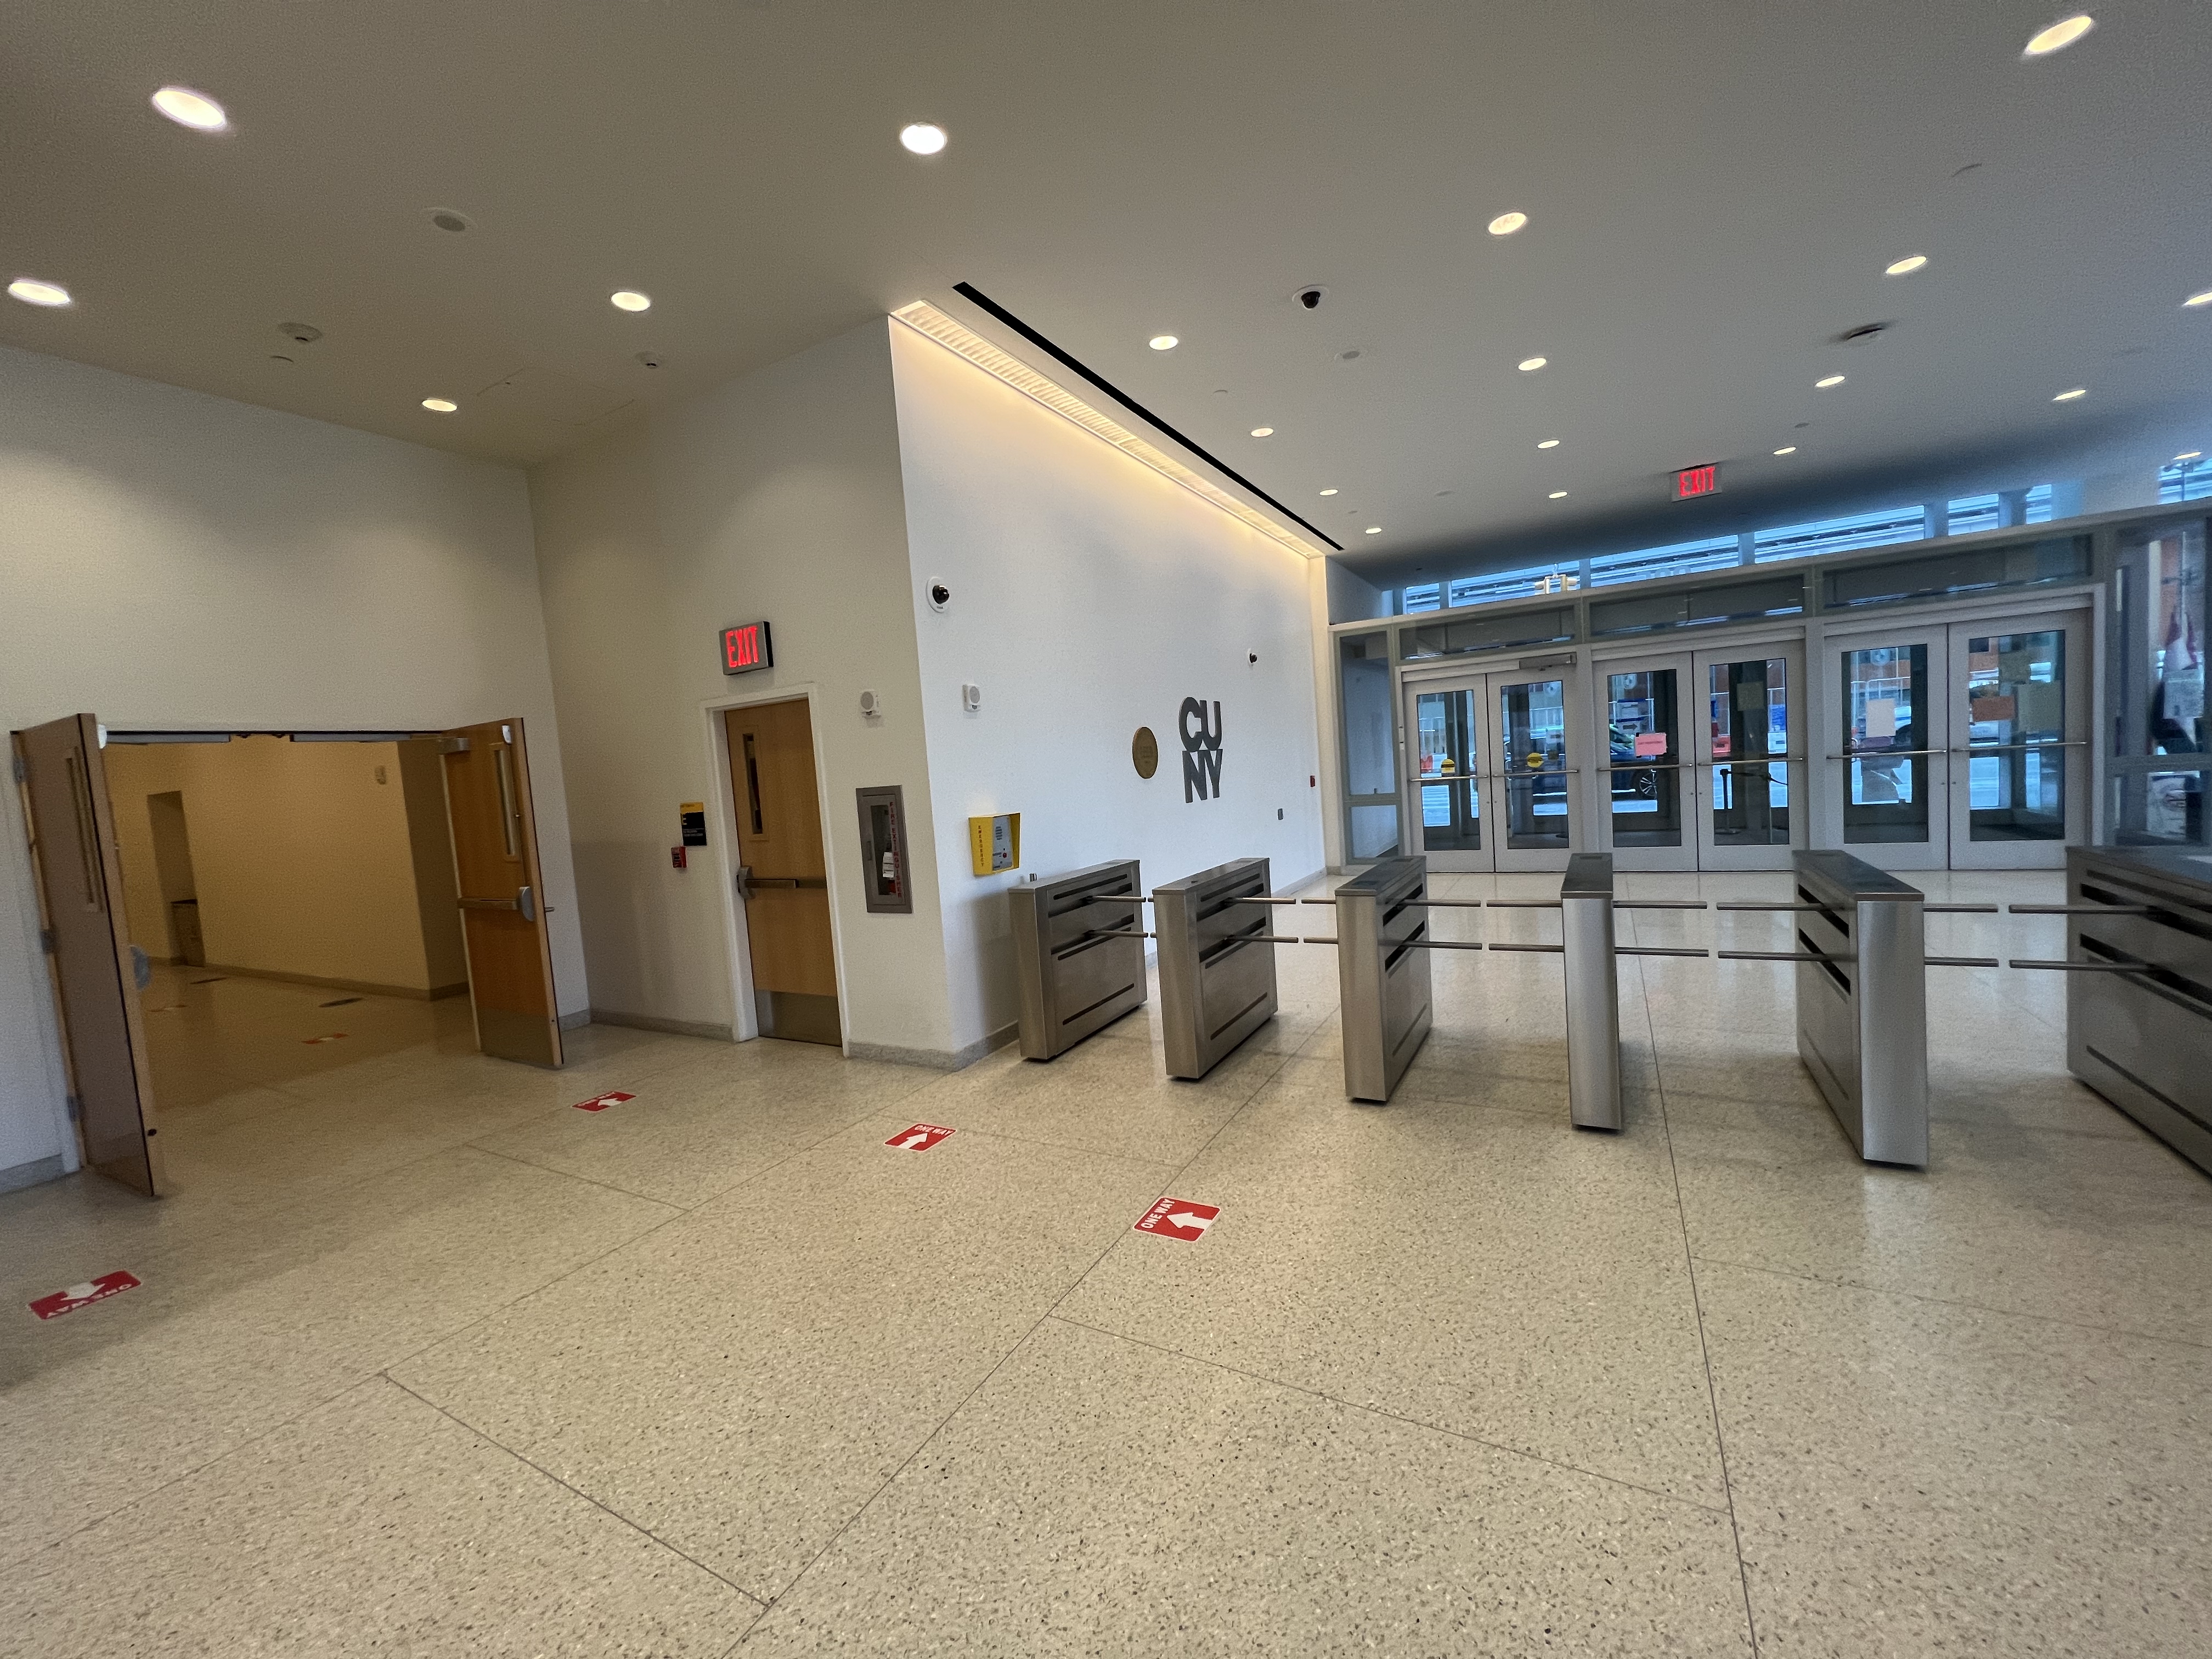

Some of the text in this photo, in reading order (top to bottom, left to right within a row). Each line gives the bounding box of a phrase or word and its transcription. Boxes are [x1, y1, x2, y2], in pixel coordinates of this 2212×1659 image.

[1680, 466, 1716, 496] EXIT
[726, 625, 758, 668] EXIT
[892, 828, 902, 898] EXTINGUISHER
[1141, 1199, 1175, 1229] ONE WAY
